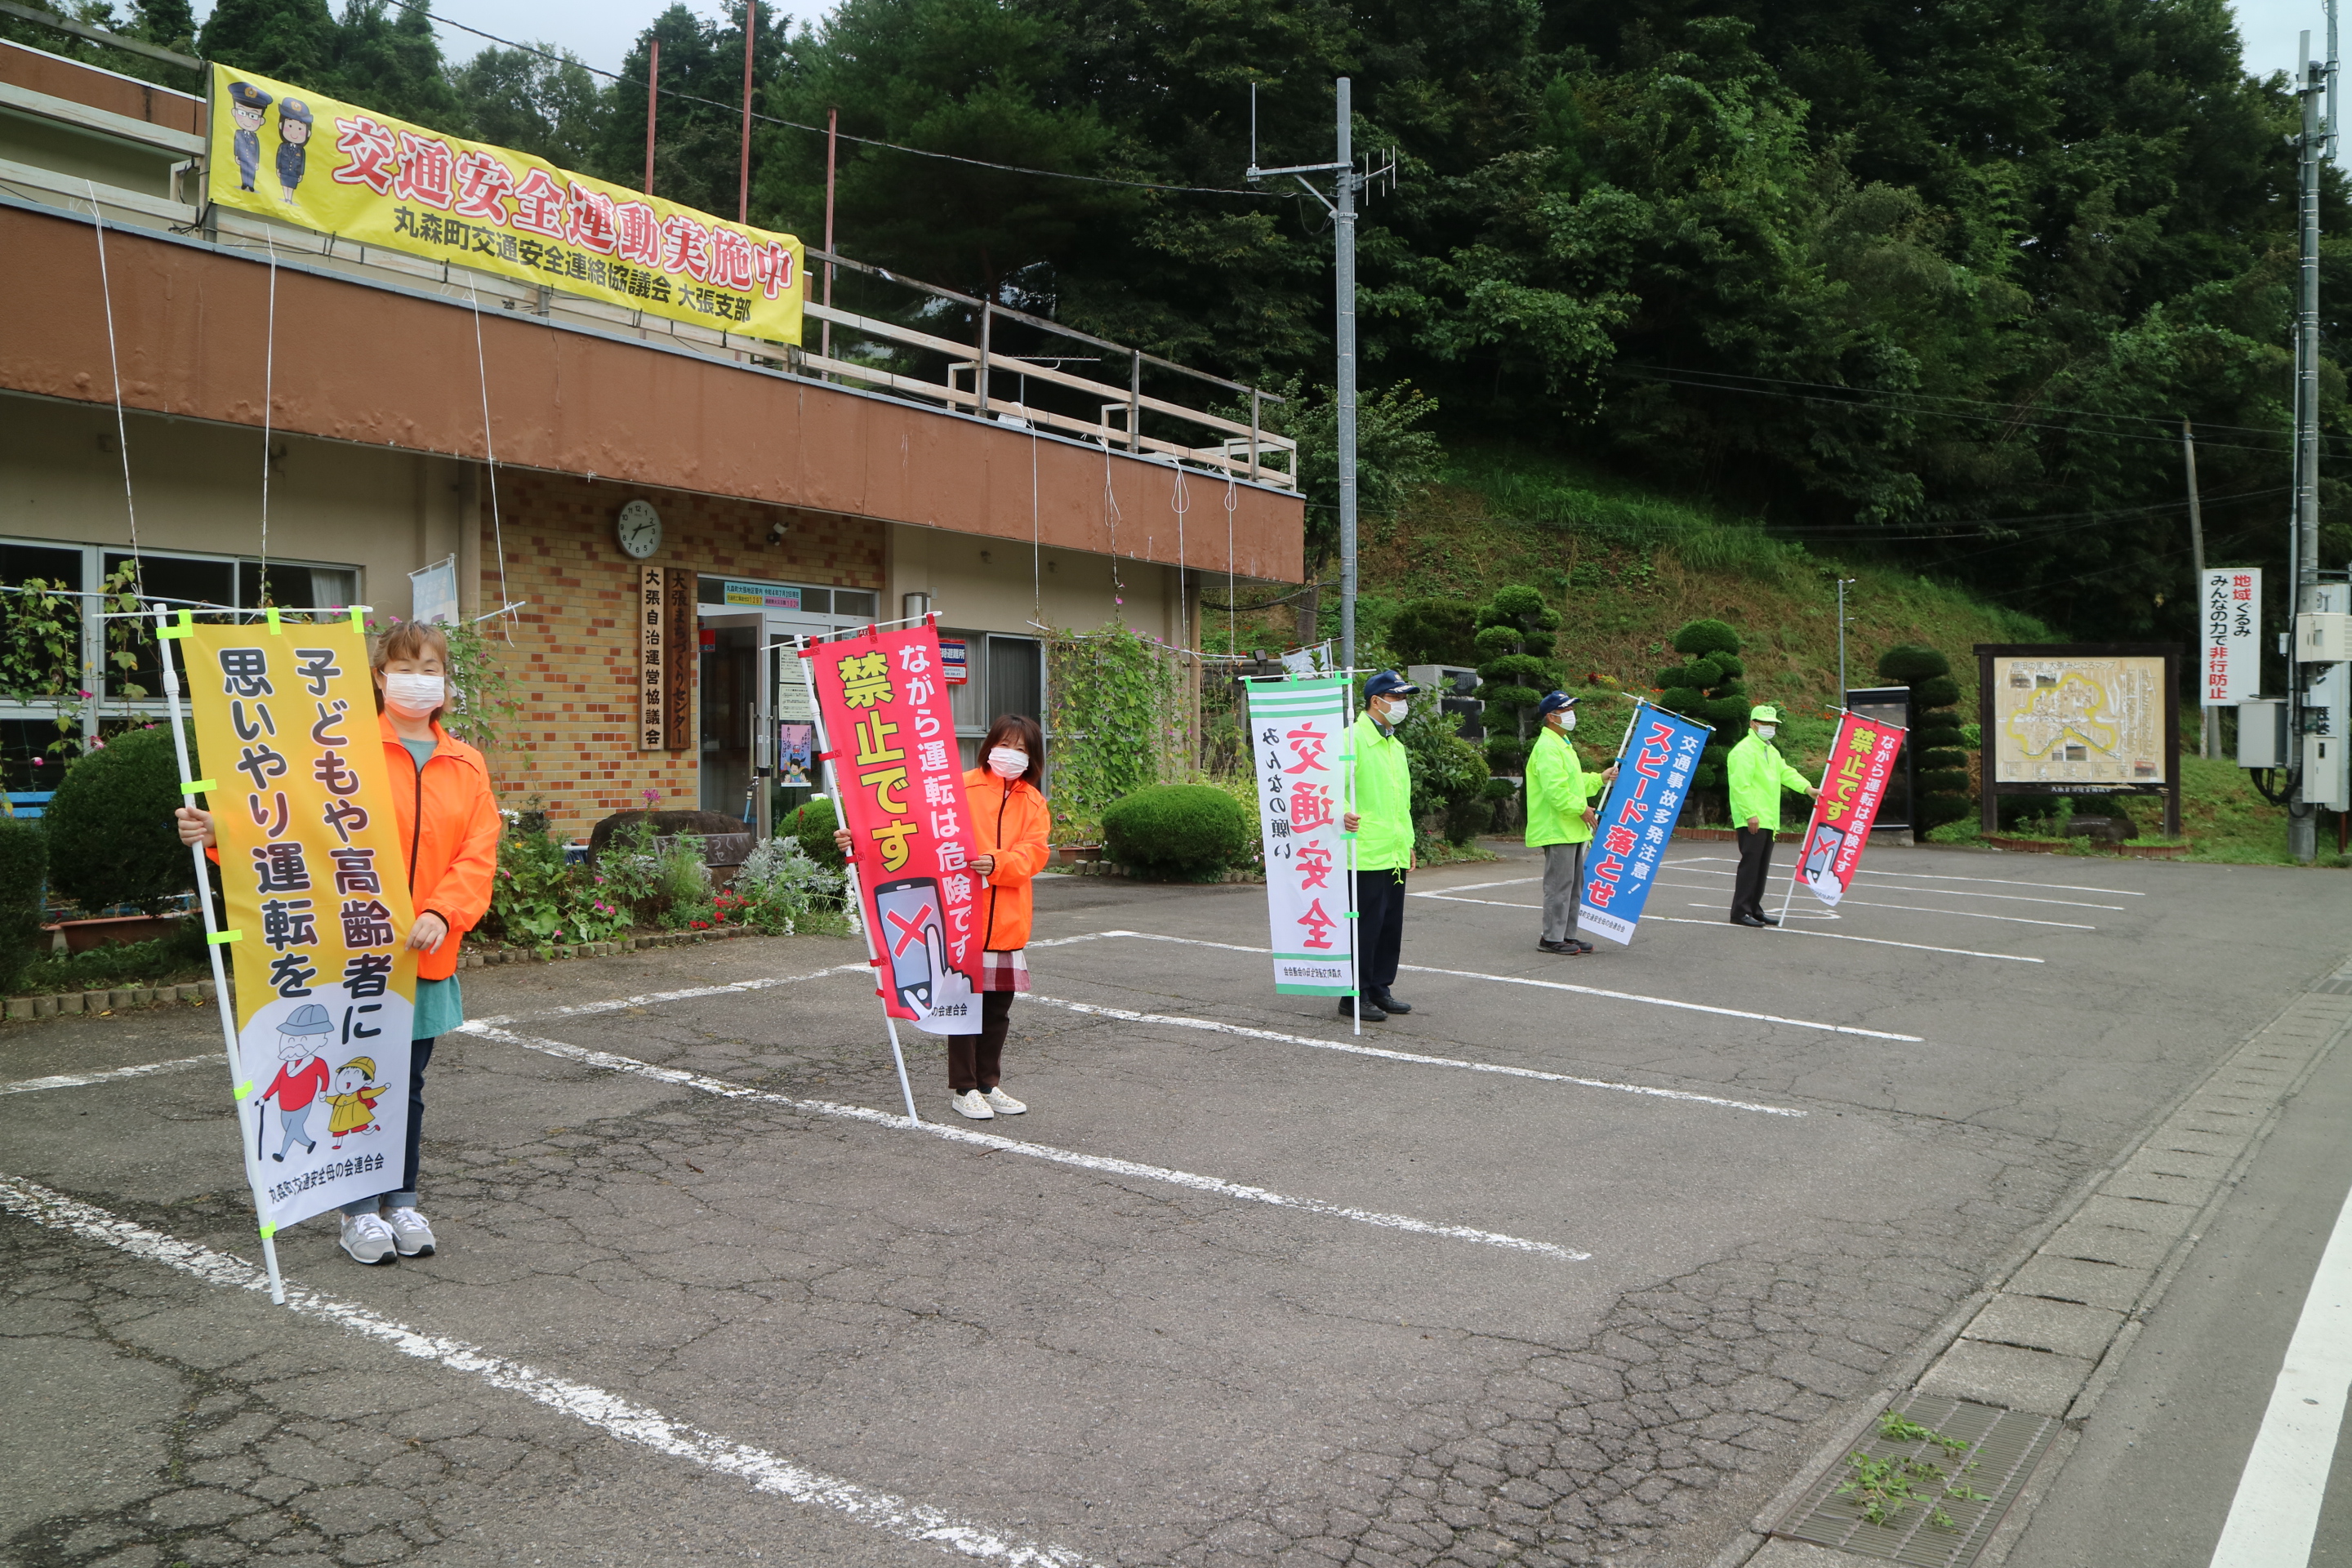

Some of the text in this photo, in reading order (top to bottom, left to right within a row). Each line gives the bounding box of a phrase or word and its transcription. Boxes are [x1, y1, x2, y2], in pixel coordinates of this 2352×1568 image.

[332, 115, 794, 300] 交通安全運動実施中
[393, 204, 752, 324] 丸森町交通安全連絡協議会 大張支部
[644, 568, 661, 745] 大張自治運営協議会
[670, 572, 688, 745] 大張まちづくりセンター
[940, 648, 965, 660] 時避難所
[2208, 575, 2229, 700] みんなの力で非行防止
[2232, 574, 2252, 638] 地域ぐるみ
[217, 648, 320, 999] 思いやり運転を
[837, 650, 919, 874] 禁止です
[898, 644, 973, 964] ながら運転は危険です
[1586, 720, 1676, 909] スピード落とせ
[1826, 726, 1878, 822] 禁止です
[1836, 734, 1896, 873] ながら運転は危険です
[294, 648, 395, 1045] 子どもや高齢者に
[928, 1002, 968, 1018] の会連合会
[268, 1152, 385, 1205] 丸森町交通安全母の会連合会
